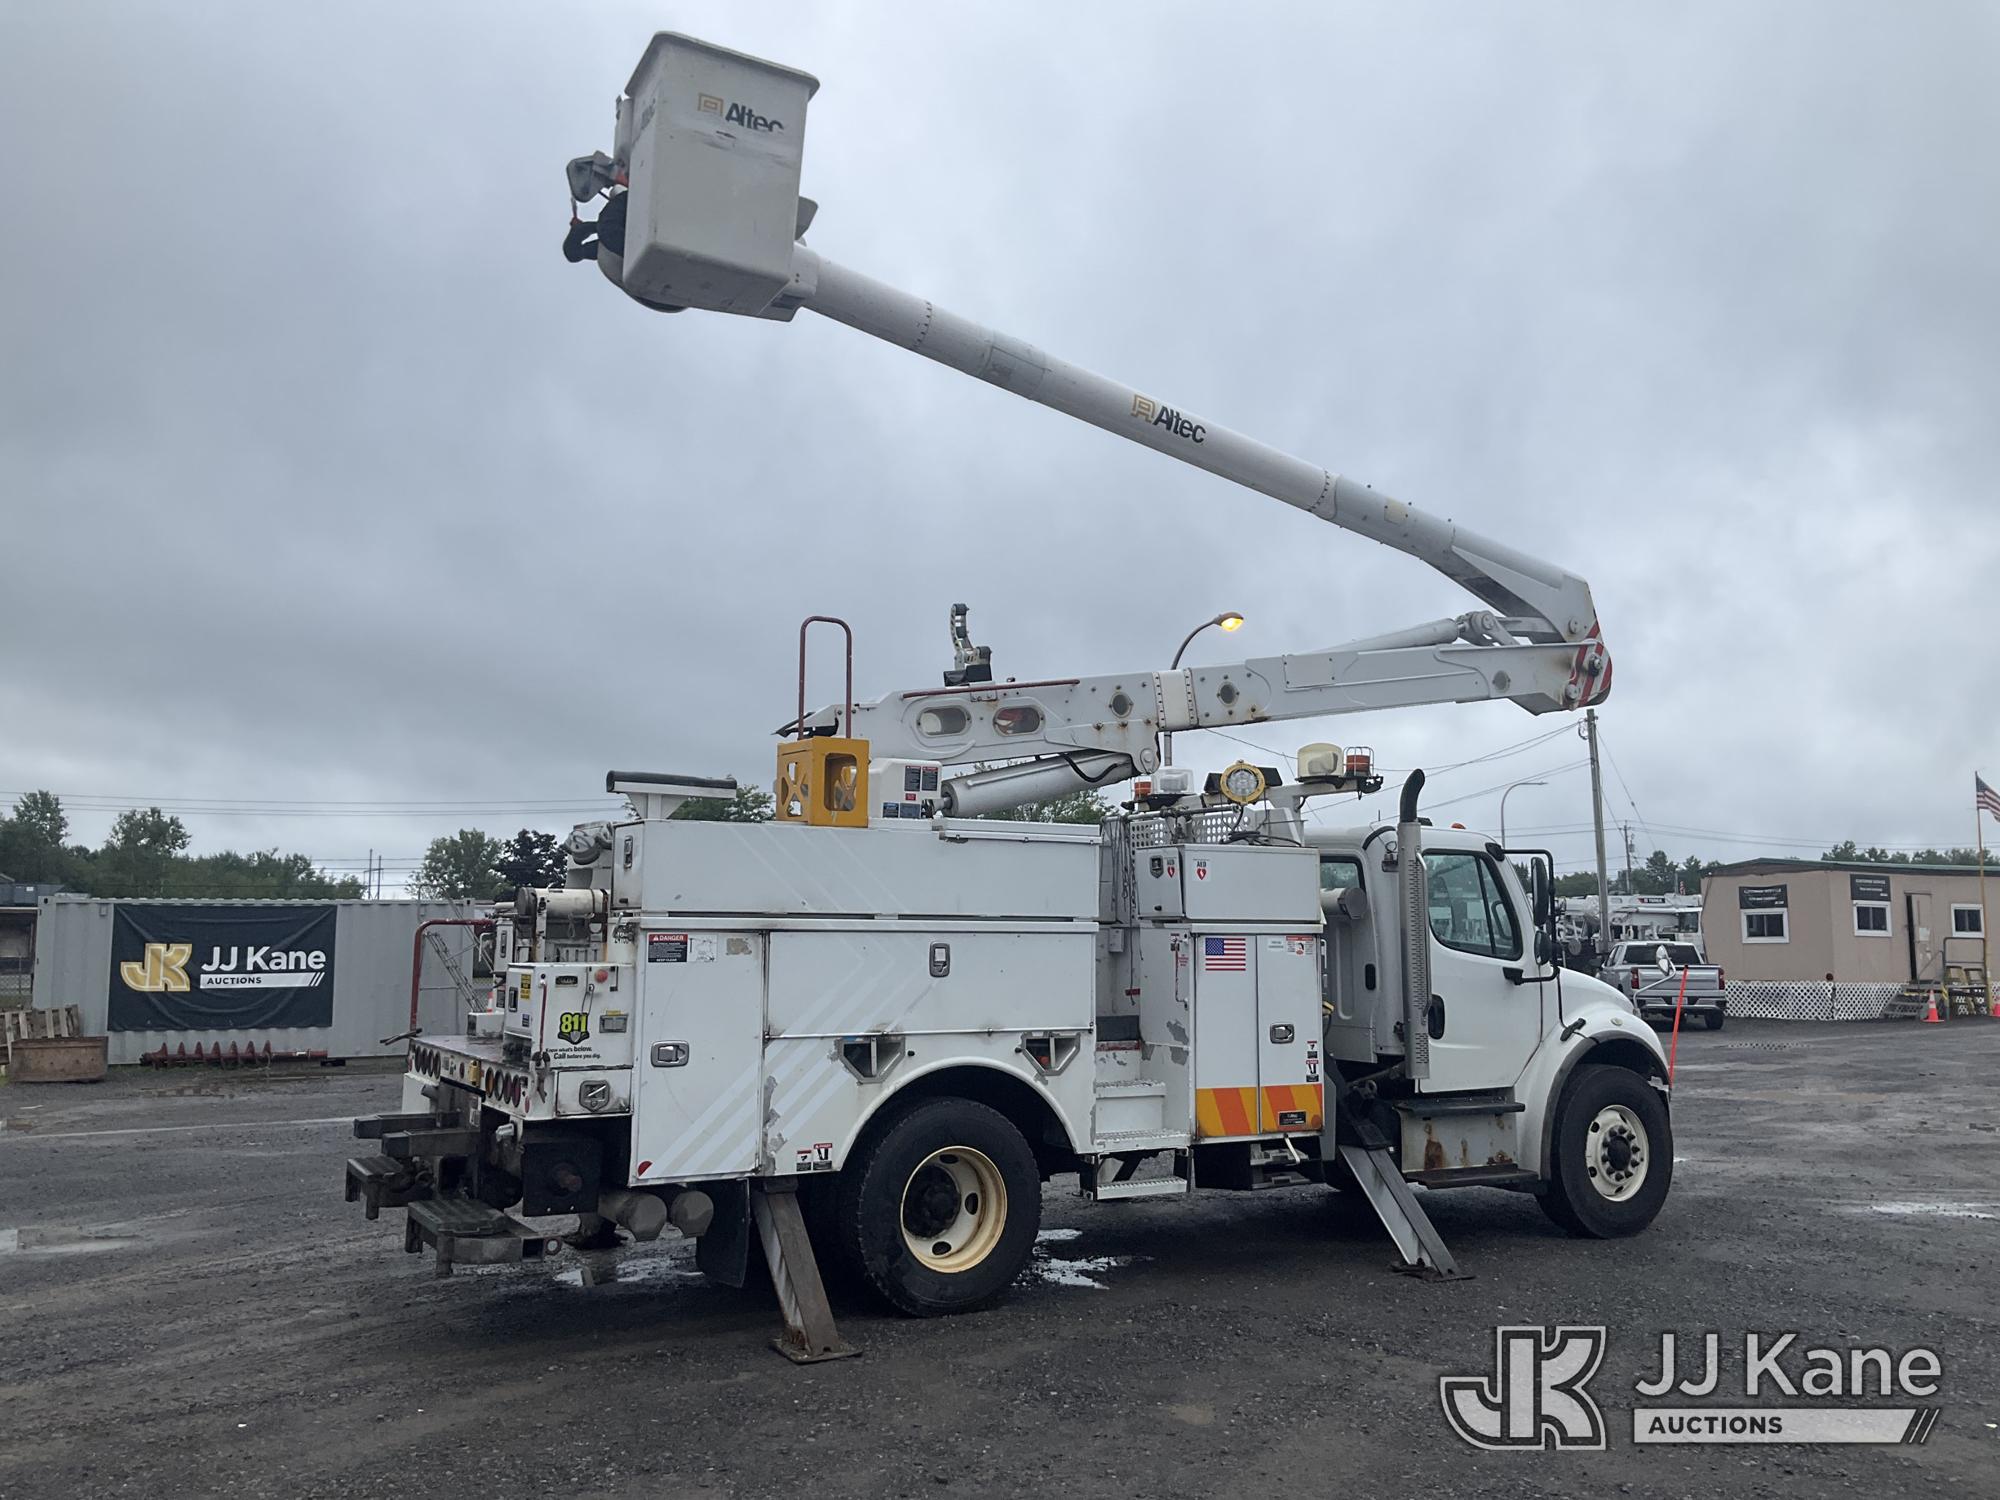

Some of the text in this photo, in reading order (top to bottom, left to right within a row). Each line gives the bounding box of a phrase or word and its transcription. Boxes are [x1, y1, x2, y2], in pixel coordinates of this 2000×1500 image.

[1152, 405, 1206, 443] Altec
[201, 946, 326, 971] JJ Kane
[206, 976, 262, 985] AUCTIONS
[560, 1013, 588, 1033] 811
